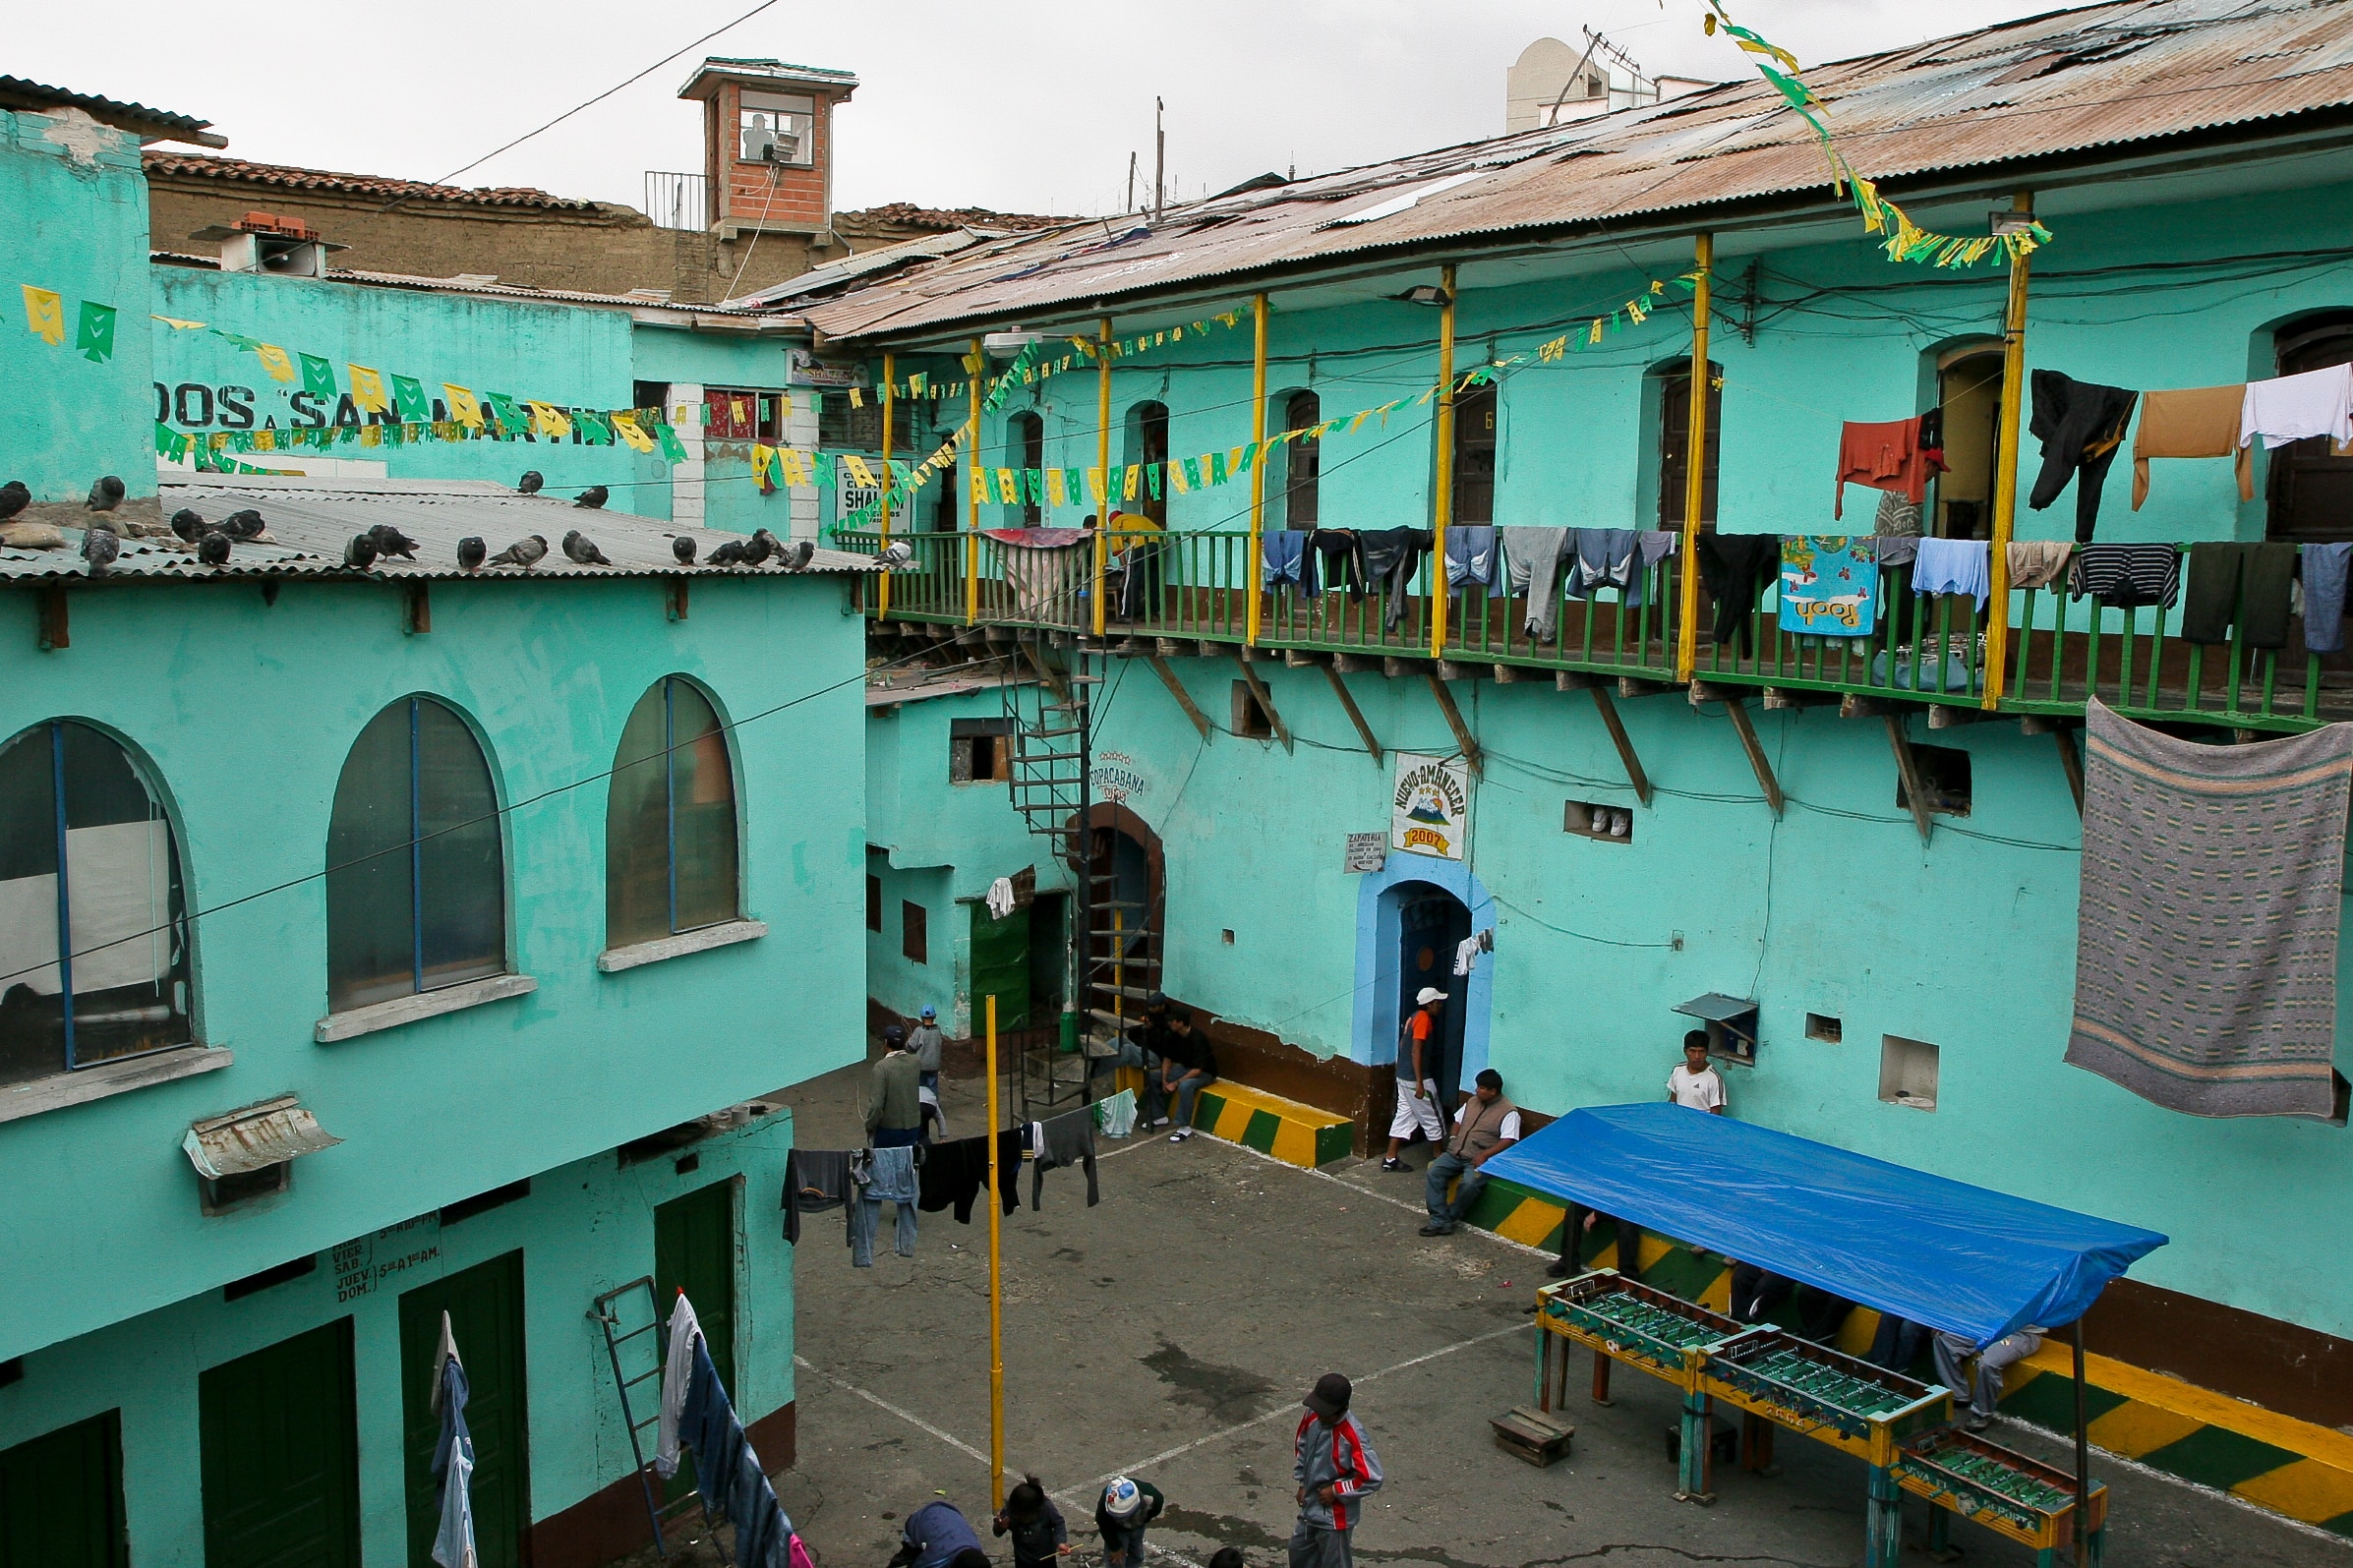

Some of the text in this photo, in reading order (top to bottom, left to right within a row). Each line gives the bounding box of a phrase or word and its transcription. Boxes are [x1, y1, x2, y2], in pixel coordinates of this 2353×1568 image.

[265, 415, 276, 431] A
[1485, 411, 1493, 430] 6
[845, 491, 904, 509] SHAL
[1794, 601, 1859, 627] Pooh
[1088, 767, 1145, 797] COPACABANA
[1411, 829, 1441, 846] 2007
[334, 1258, 364, 1275] SAB.
[336, 1268, 372, 1290] JUEV.
[337, 1282, 372, 1304] DOM.
